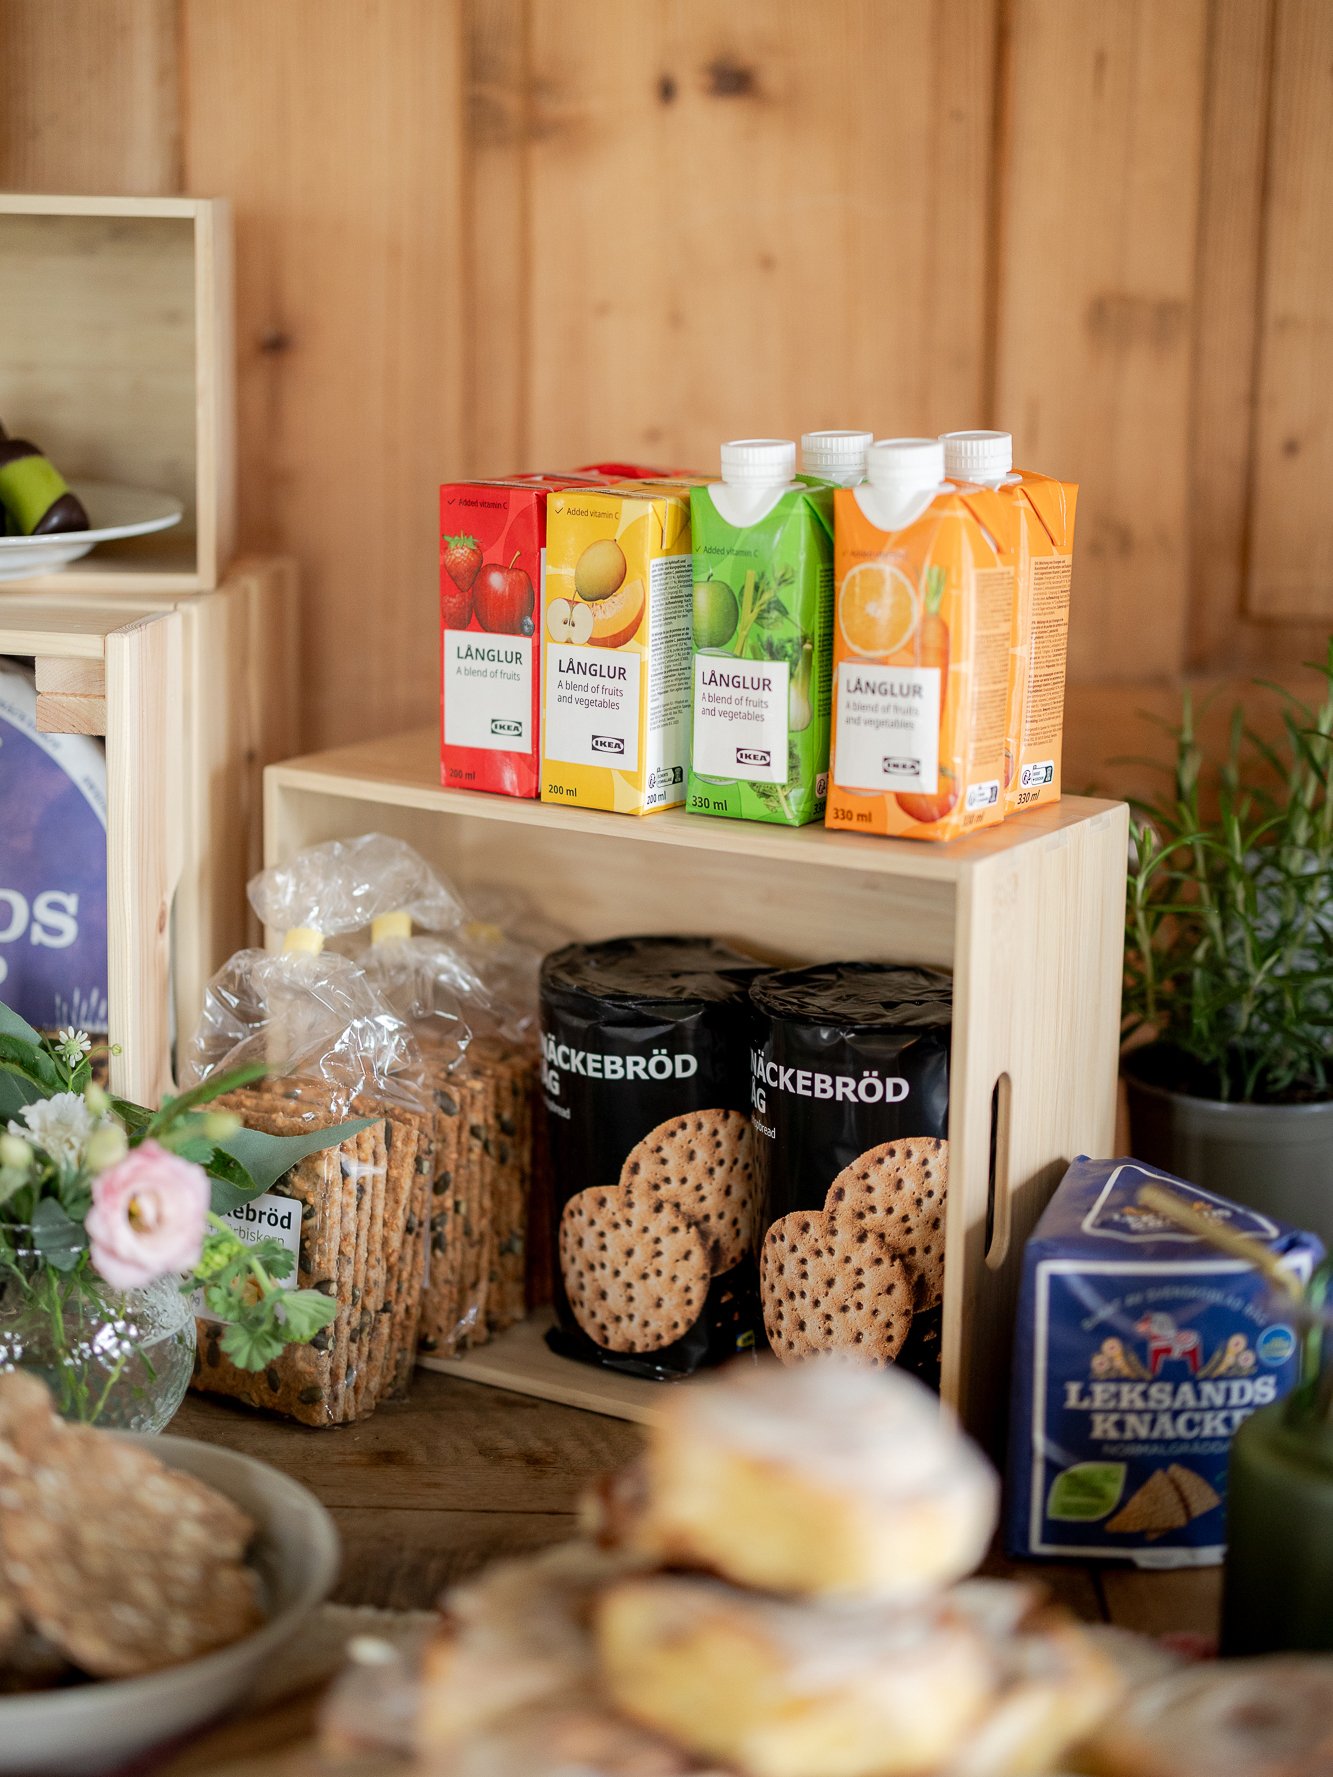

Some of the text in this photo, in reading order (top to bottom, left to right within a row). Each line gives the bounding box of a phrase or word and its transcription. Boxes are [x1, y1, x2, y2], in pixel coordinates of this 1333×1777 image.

[458, 498, 508, 510] Added vitamin C
[566, 507, 620, 520] Added vitamin C
[703, 546, 759, 558] Added vitamin C
[456, 644, 523, 665] LÅNGLUR
[456, 666, 521, 681] A blend of fruits
[558, 658, 627, 681] LÅNGLUR
[701, 669, 772, 692] LÅNGLUR
[846, 677, 923, 699] LÅNGLUR
[557, 680, 624, 697] A blend of fruits
[557, 693, 620, 711] and vegetables
[701, 692, 769, 709] A blend of fruits
[701, 707, 765, 722] and vegetables
[493, 722, 521, 733] IKEA
[594, 738, 623, 751] IKEA
[739, 751, 769, 763] IKEA
[450, 768, 476, 780] 200 ml
[548, 784, 577, 798] 200 ml
[647, 790, 667, 805] 200 ml
[1017, 789, 1041, 805] 330 ml
[692, 795, 728, 811] 330 ml
[813, 801, 825, 815] 330
[832, 808, 872, 823] 330 ml
[1063, 1374, 1277, 1411] LEKSANDS
